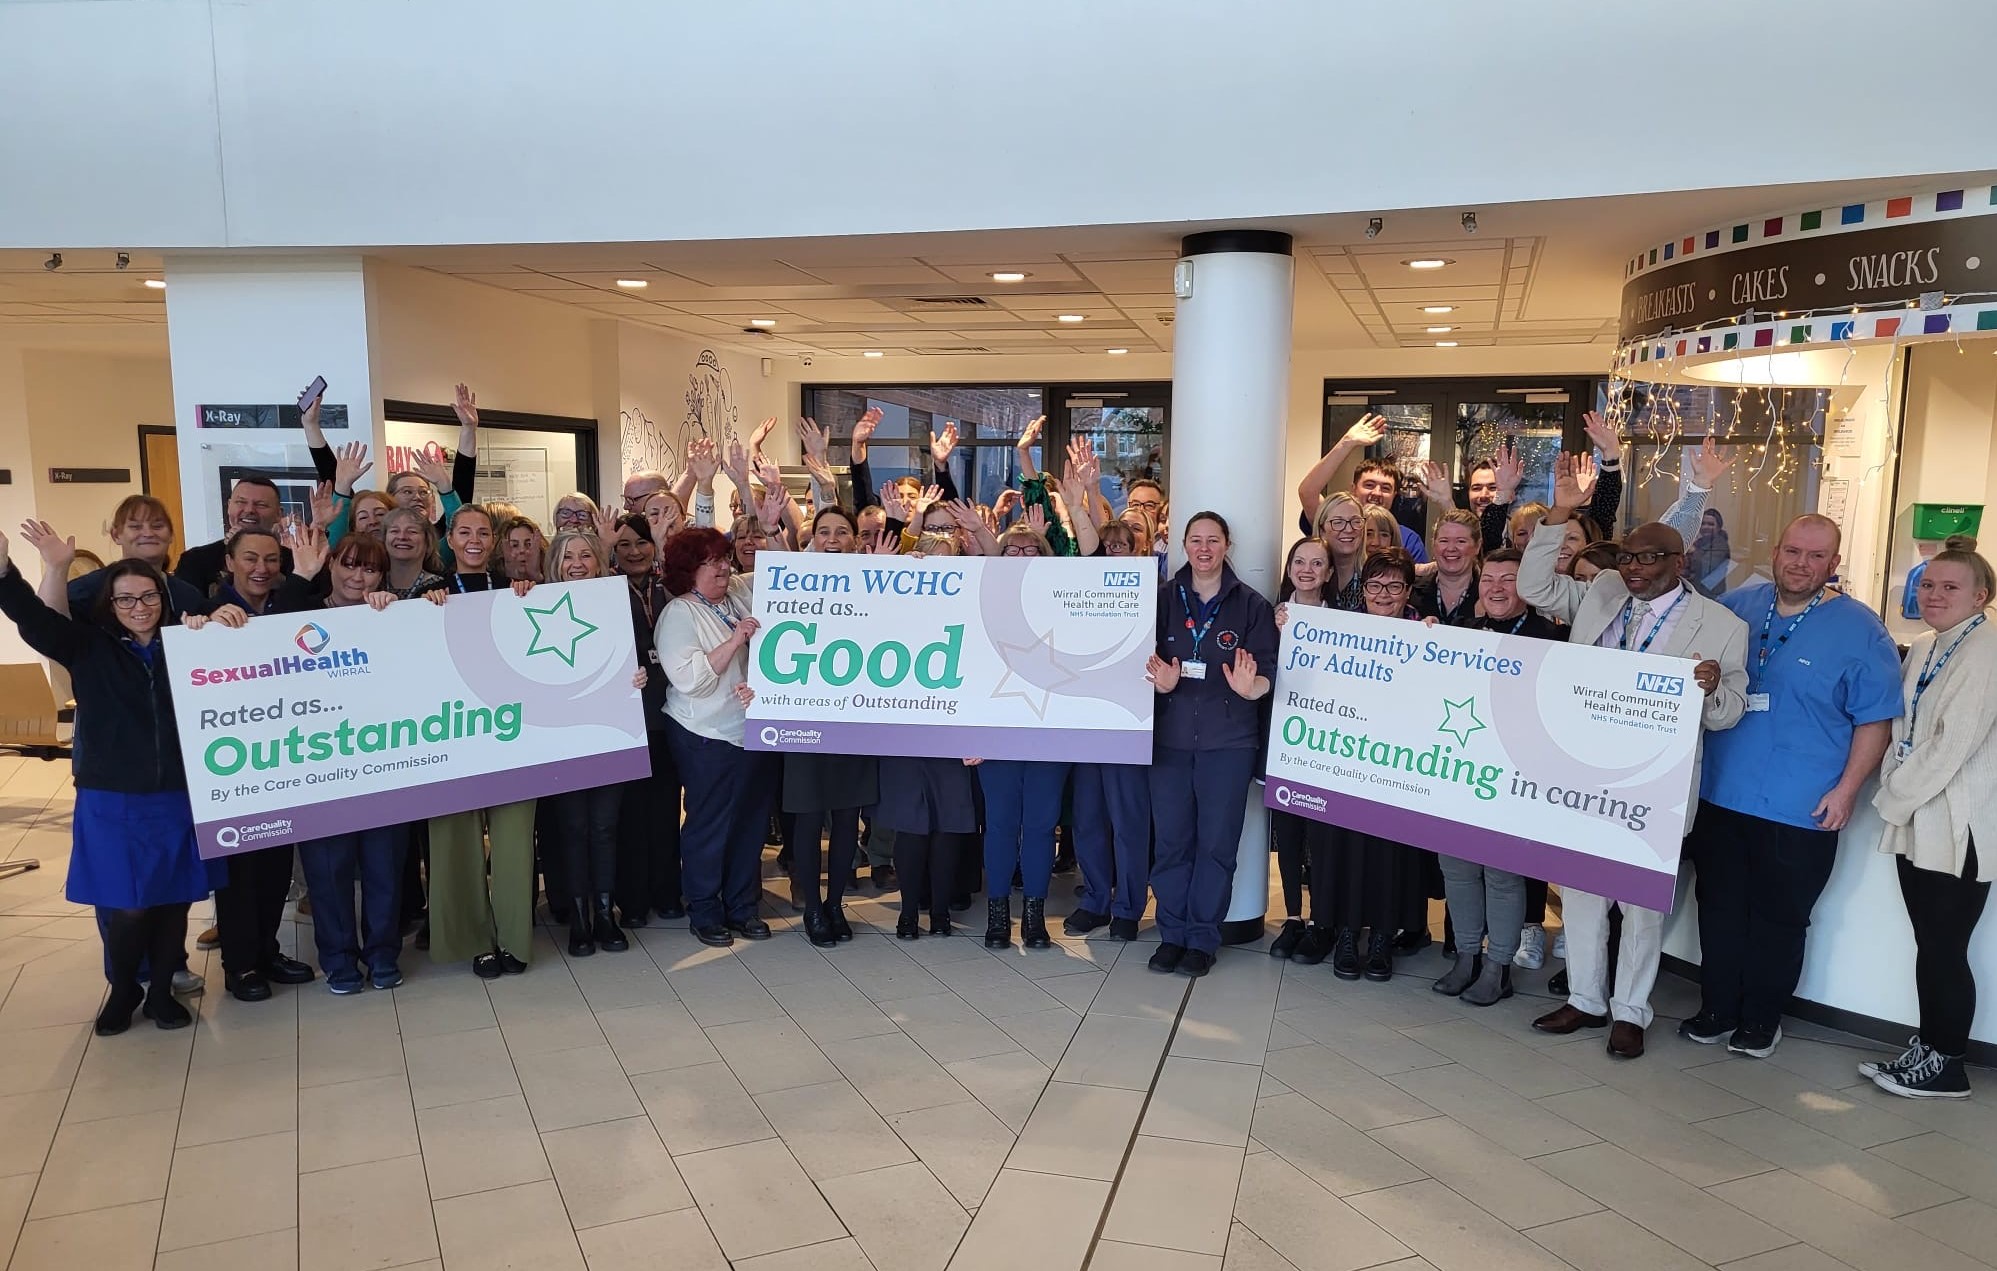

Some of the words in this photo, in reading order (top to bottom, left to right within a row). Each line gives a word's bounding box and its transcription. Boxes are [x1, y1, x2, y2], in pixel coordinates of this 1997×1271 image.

[1637, 282, 1697, 325] BREAKFASTS
[1731, 265, 1789, 305] CAKES
[1847, 247, 1940, 291] SNACKS
[205, 410, 241, 426] X-Ray
[54, 471, 73, 482] X-Ray
[767, 565, 851, 594] Team
[862, 569, 964, 597] WCHC
[1104, 572, 1139, 586] NHS
[1052, 589, 1082, 599] Wirral
[1084, 589, 1140, 601] Community
[1063, 600, 1095, 609] Health
[1097, 600, 1115, 609] and
[1118, 600, 1140, 609] Care
[765, 597, 824, 616] rated
[829, 601, 869, 618] as...
[758, 619, 966, 690] Good
[1292, 620, 1419, 664] Community
[1422, 640, 1523, 677] Services
[327, 666, 372, 679] WIRRAL
[1285, 645, 1321, 672] for
[1324, 652, 1395, 683] Adults
[1637, 673, 1684, 695] NHS
[760, 693, 791, 706] with
[793, 696, 831, 707] areas
[833, 695, 850, 711] of
[852, 693, 959, 715] Outstanding
[1286, 690, 1334, 718] Rated
[1338, 702, 1369, 722] as...
[1573, 684, 1608, 700] Wirral
[1611, 690, 1680, 713] Community
[200, 697, 283, 730] Rated
[291, 698, 343, 717] as...
[1584, 699, 1621, 715] Health
[1625, 707, 1648, 718] and
[1651, 710, 1679, 724] Care
[1590, 713, 1608, 722] NHS
[1609, 716, 1654, 730] Foundation
[1657, 724, 1677, 734] Trust
[203, 699, 523, 777] Outstanding
[779, 736, 821, 745] Commission
[210, 788, 231, 802] By
[235, 783, 260, 797] the
[264, 777, 302, 792] Care
[305, 767, 359, 785] Quality
[362, 753, 449, 776] Commission
[1280, 752, 1293, 765] By
[1293, 757, 1309, 767] the
[1309, 759, 1331, 773] Care
[1332, 765, 1369, 783] Quality
[1370, 773, 1431, 796] Commission
[1282, 715, 1504, 801] Outstanding
[1510, 771, 1538, 800] in
[1546, 786, 1652, 832] caring
[1290, 797, 1327, 813] Commission
[241, 827, 293, 842] Commission
